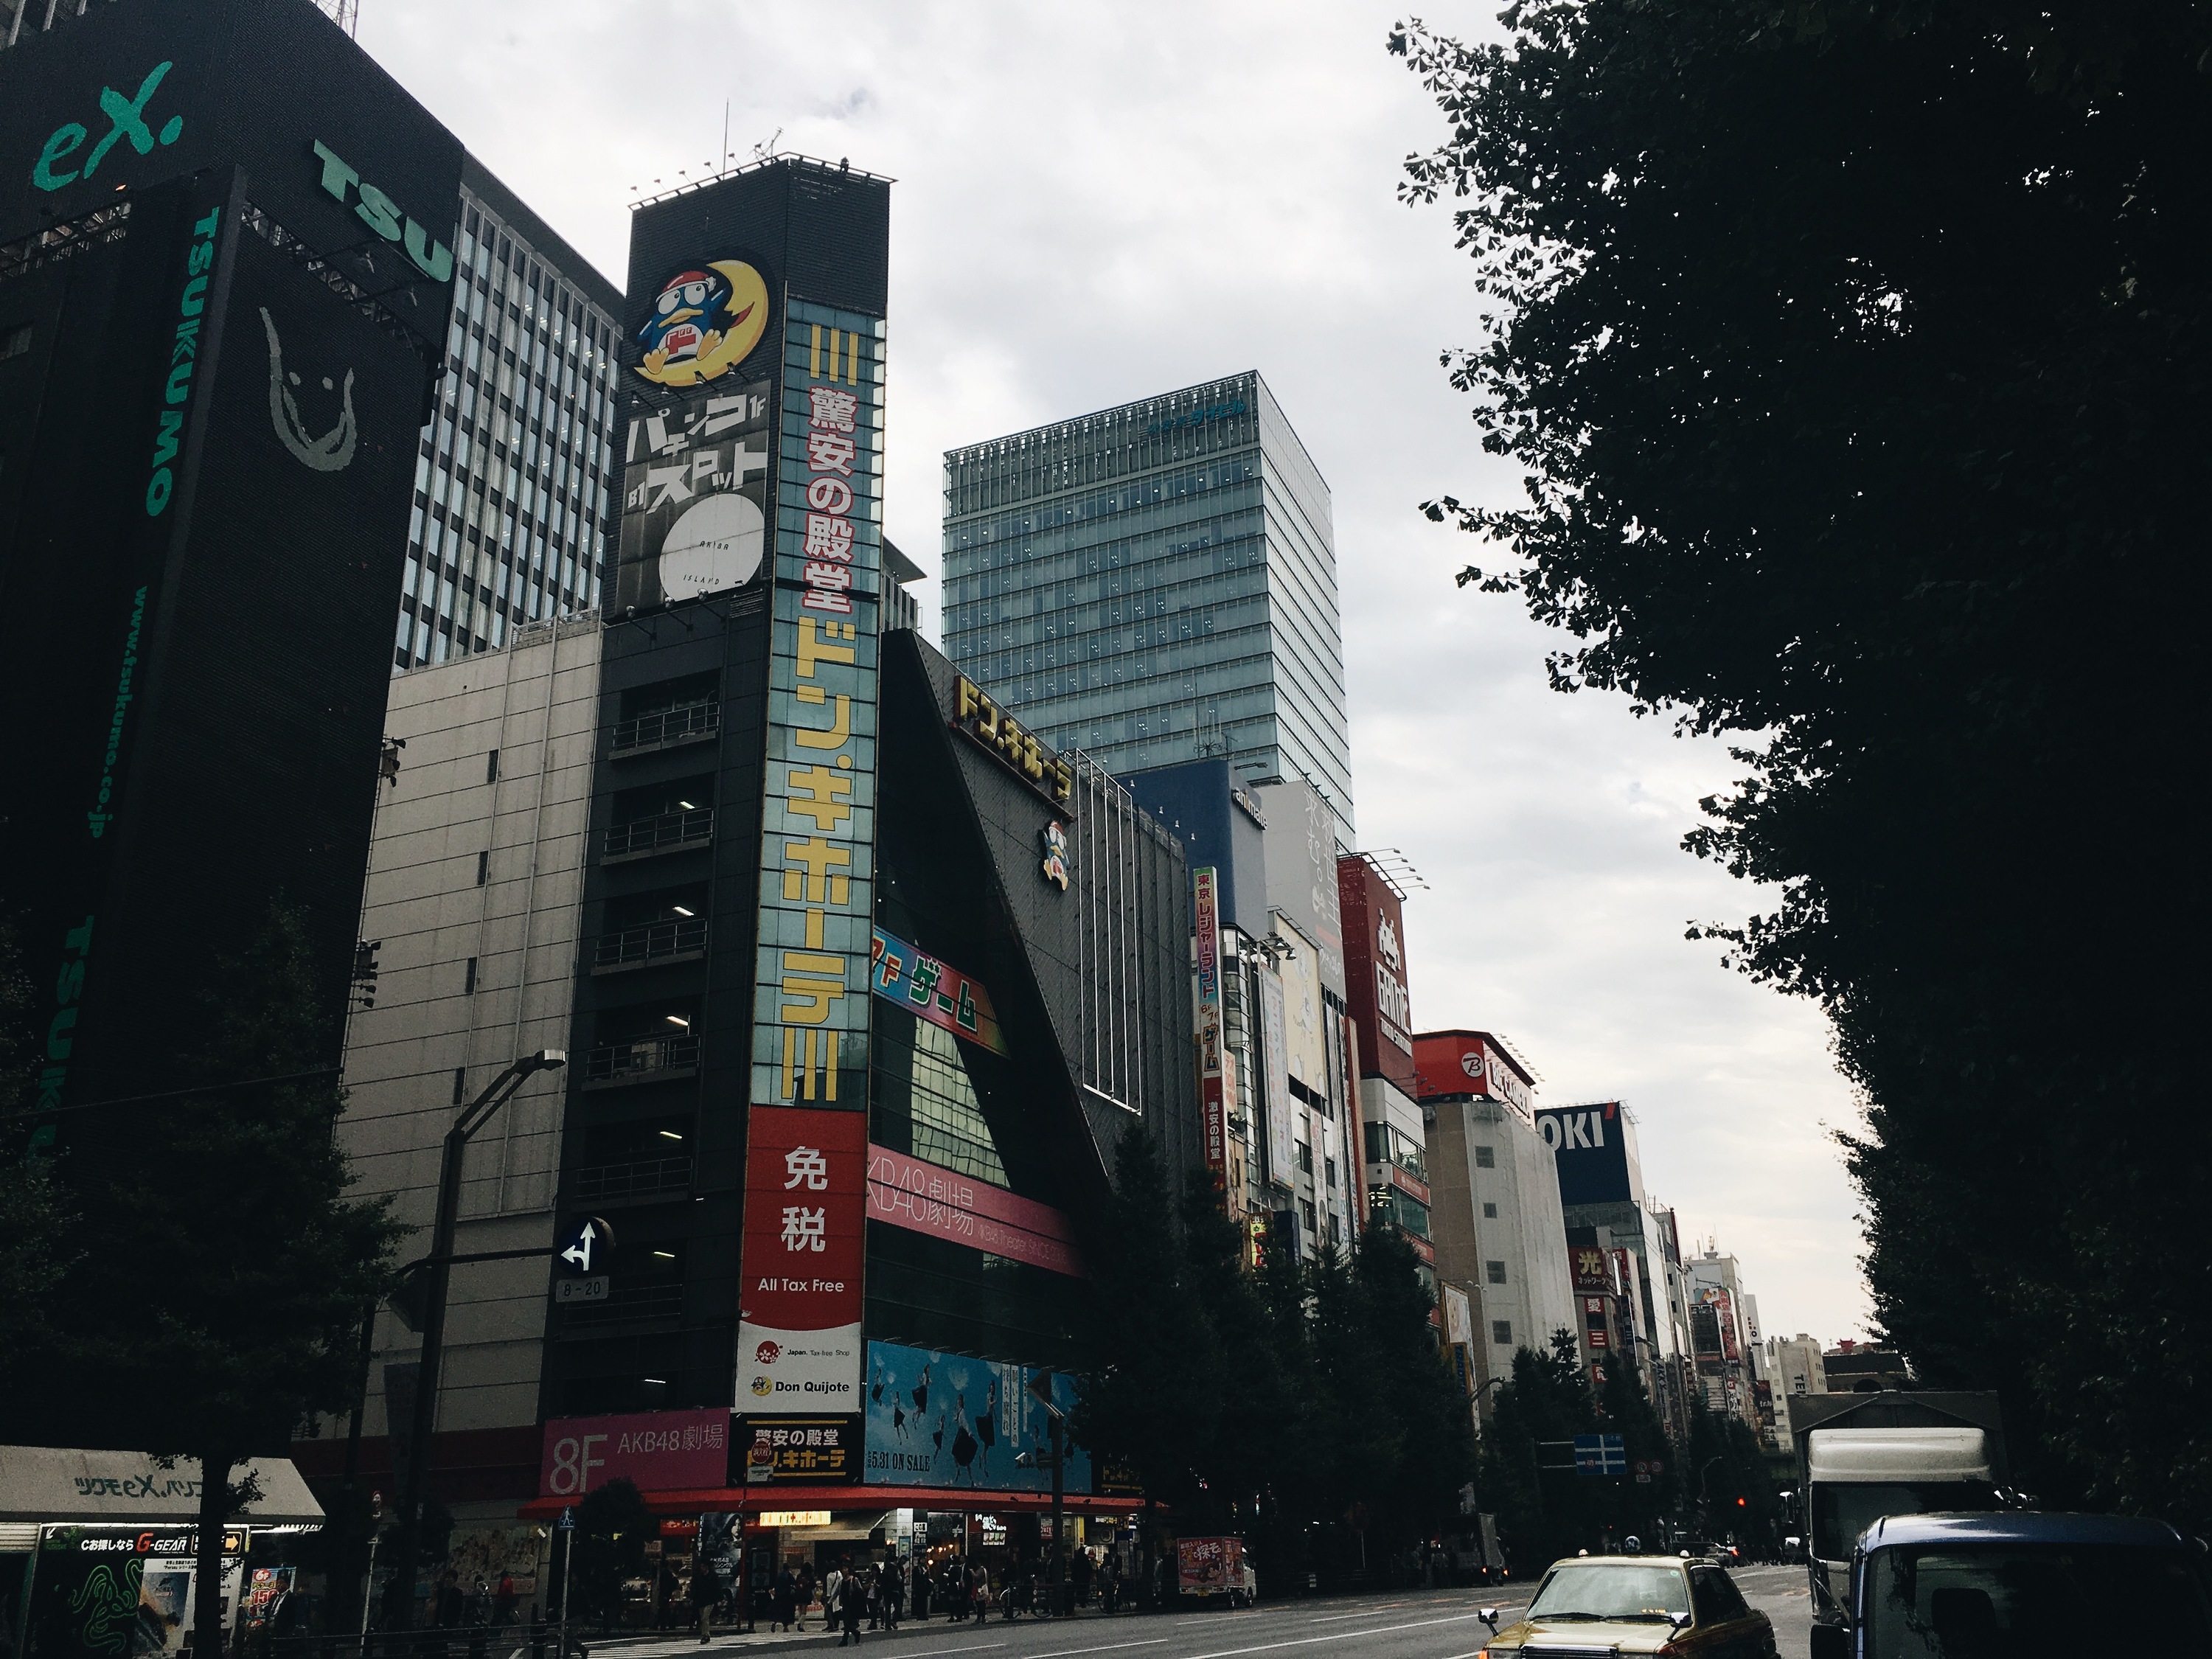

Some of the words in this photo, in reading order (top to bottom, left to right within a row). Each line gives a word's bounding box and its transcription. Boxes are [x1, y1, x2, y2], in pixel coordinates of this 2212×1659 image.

[313, 139, 453, 282] TSU
[146, 206, 220, 516] TSUKUMO
[626, 394, 747, 463] パチンコ
[749, 393, 767, 420] 1F
[627, 481, 646, 509] B1
[646, 442, 768, 515] スロット
[802, 387, 858, 614] 驚安の殿堂
[699, 540, 730, 551] AKIBA
[87, 585, 147, 838] www.tsukumo.co.jp
[1197, 874, 1214, 1000] 東京レジャーランド
[908, 955, 978, 1033] ゲーム
[1200, 1004, 1212, 1014] 6F
[1203, 1022, 1220, 1073] ゲーム
[780, 1144, 830, 1253] 免税
[758, 1278, 778, 1292] All
[782, 1279, 809, 1293] Tax
[813, 1279, 845, 1293] Free
[1578, 1251, 1601, 1275] 光
[775, 1381, 800, 1392] Don
[804, 1381, 850, 1394] Quijote
[549, 1434, 608, 1495] 8F
[616, 1424, 724, 1455] AKB48劇場
[872, 1451, 889, 1469] 5.31
[892, 1453, 905, 1470] ON
[907, 1454, 931, 1472] SALE
[136, 1532, 187, 1553] G-GEAR
[255, 1571, 270, 1582] 6F
